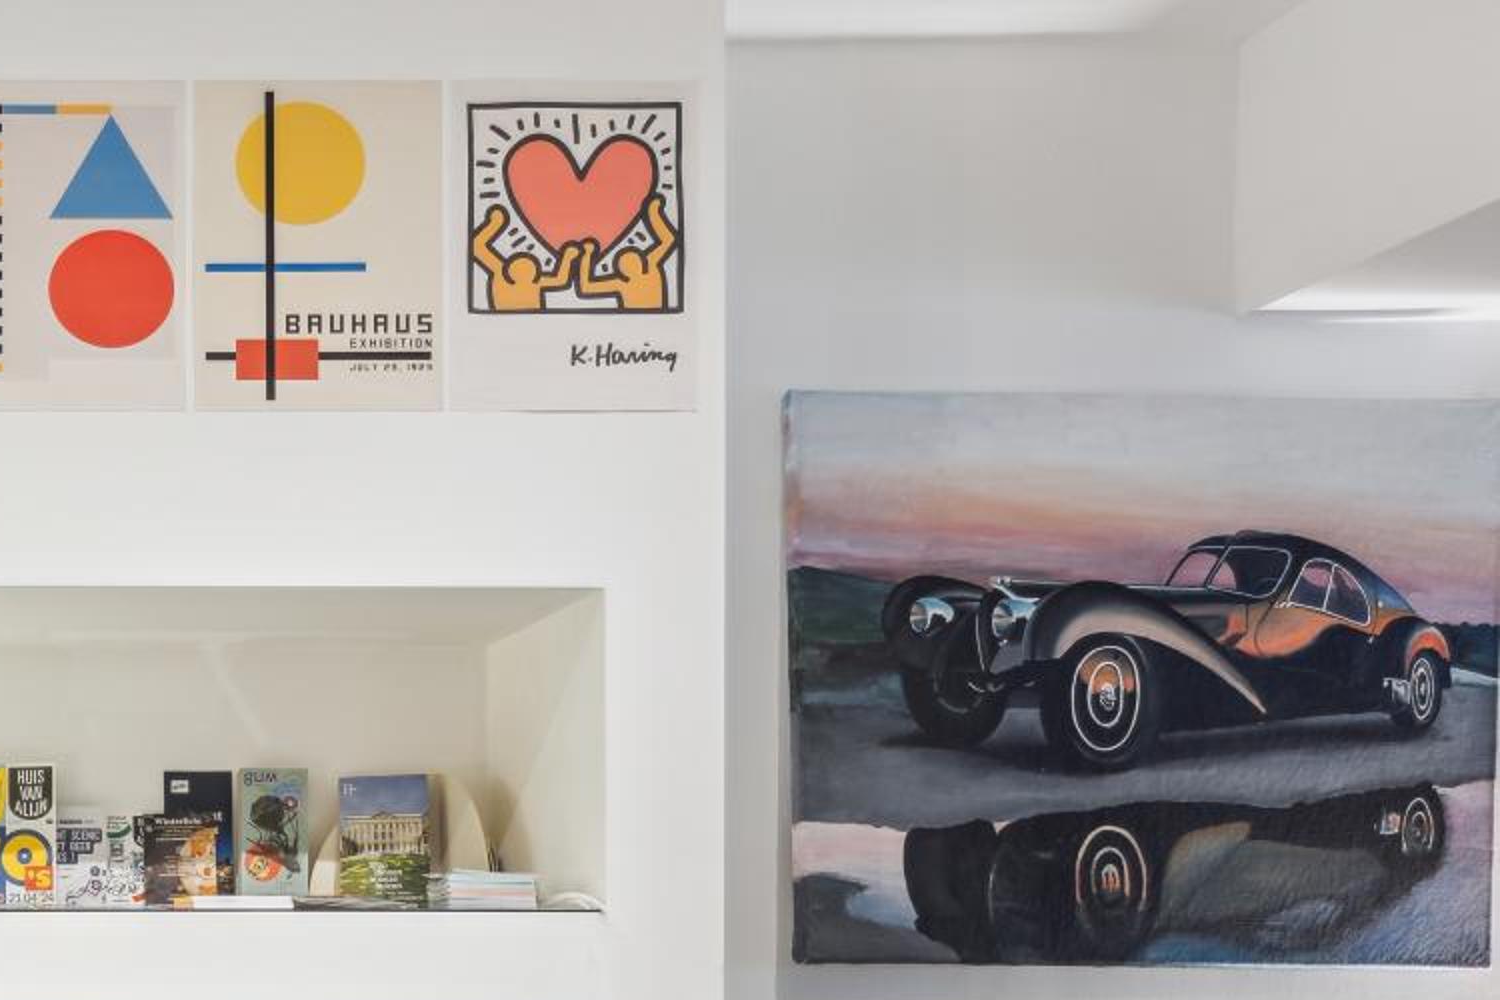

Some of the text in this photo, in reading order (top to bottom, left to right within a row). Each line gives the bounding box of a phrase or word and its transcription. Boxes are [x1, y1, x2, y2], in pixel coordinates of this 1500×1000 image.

[285, 313, 433, 335] BAUHAUS
[349, 338, 434, 349] EXHIBITION
[17, 769, 45, 784] HUIS
[19, 785, 43, 800] VAN
[15, 797, 49, 817] ALIJN
